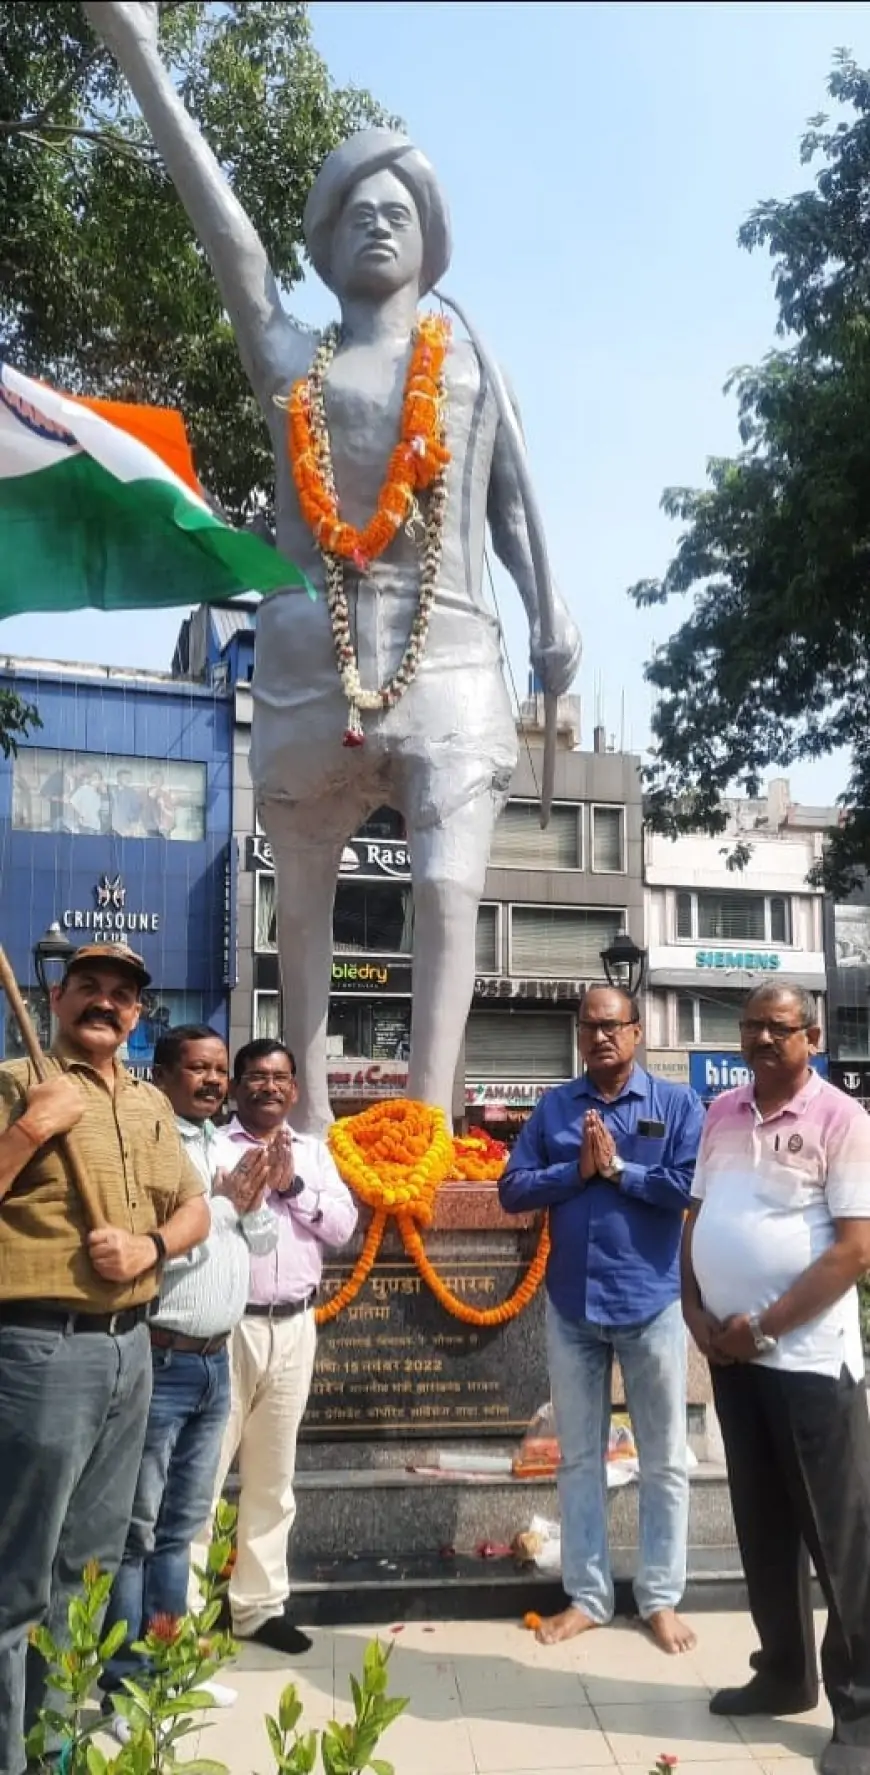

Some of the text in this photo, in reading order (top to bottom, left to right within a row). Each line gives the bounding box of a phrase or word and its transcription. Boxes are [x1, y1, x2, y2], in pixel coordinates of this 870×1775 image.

[62, 909, 161, 931] CRIMSOUNE
[695, 951, 780, 970] SIEMENS
[332, 963, 388, 984] bledry
[485, 1085, 533, 1099] ANJALI
[404, 1358, 443, 1372] 2022
